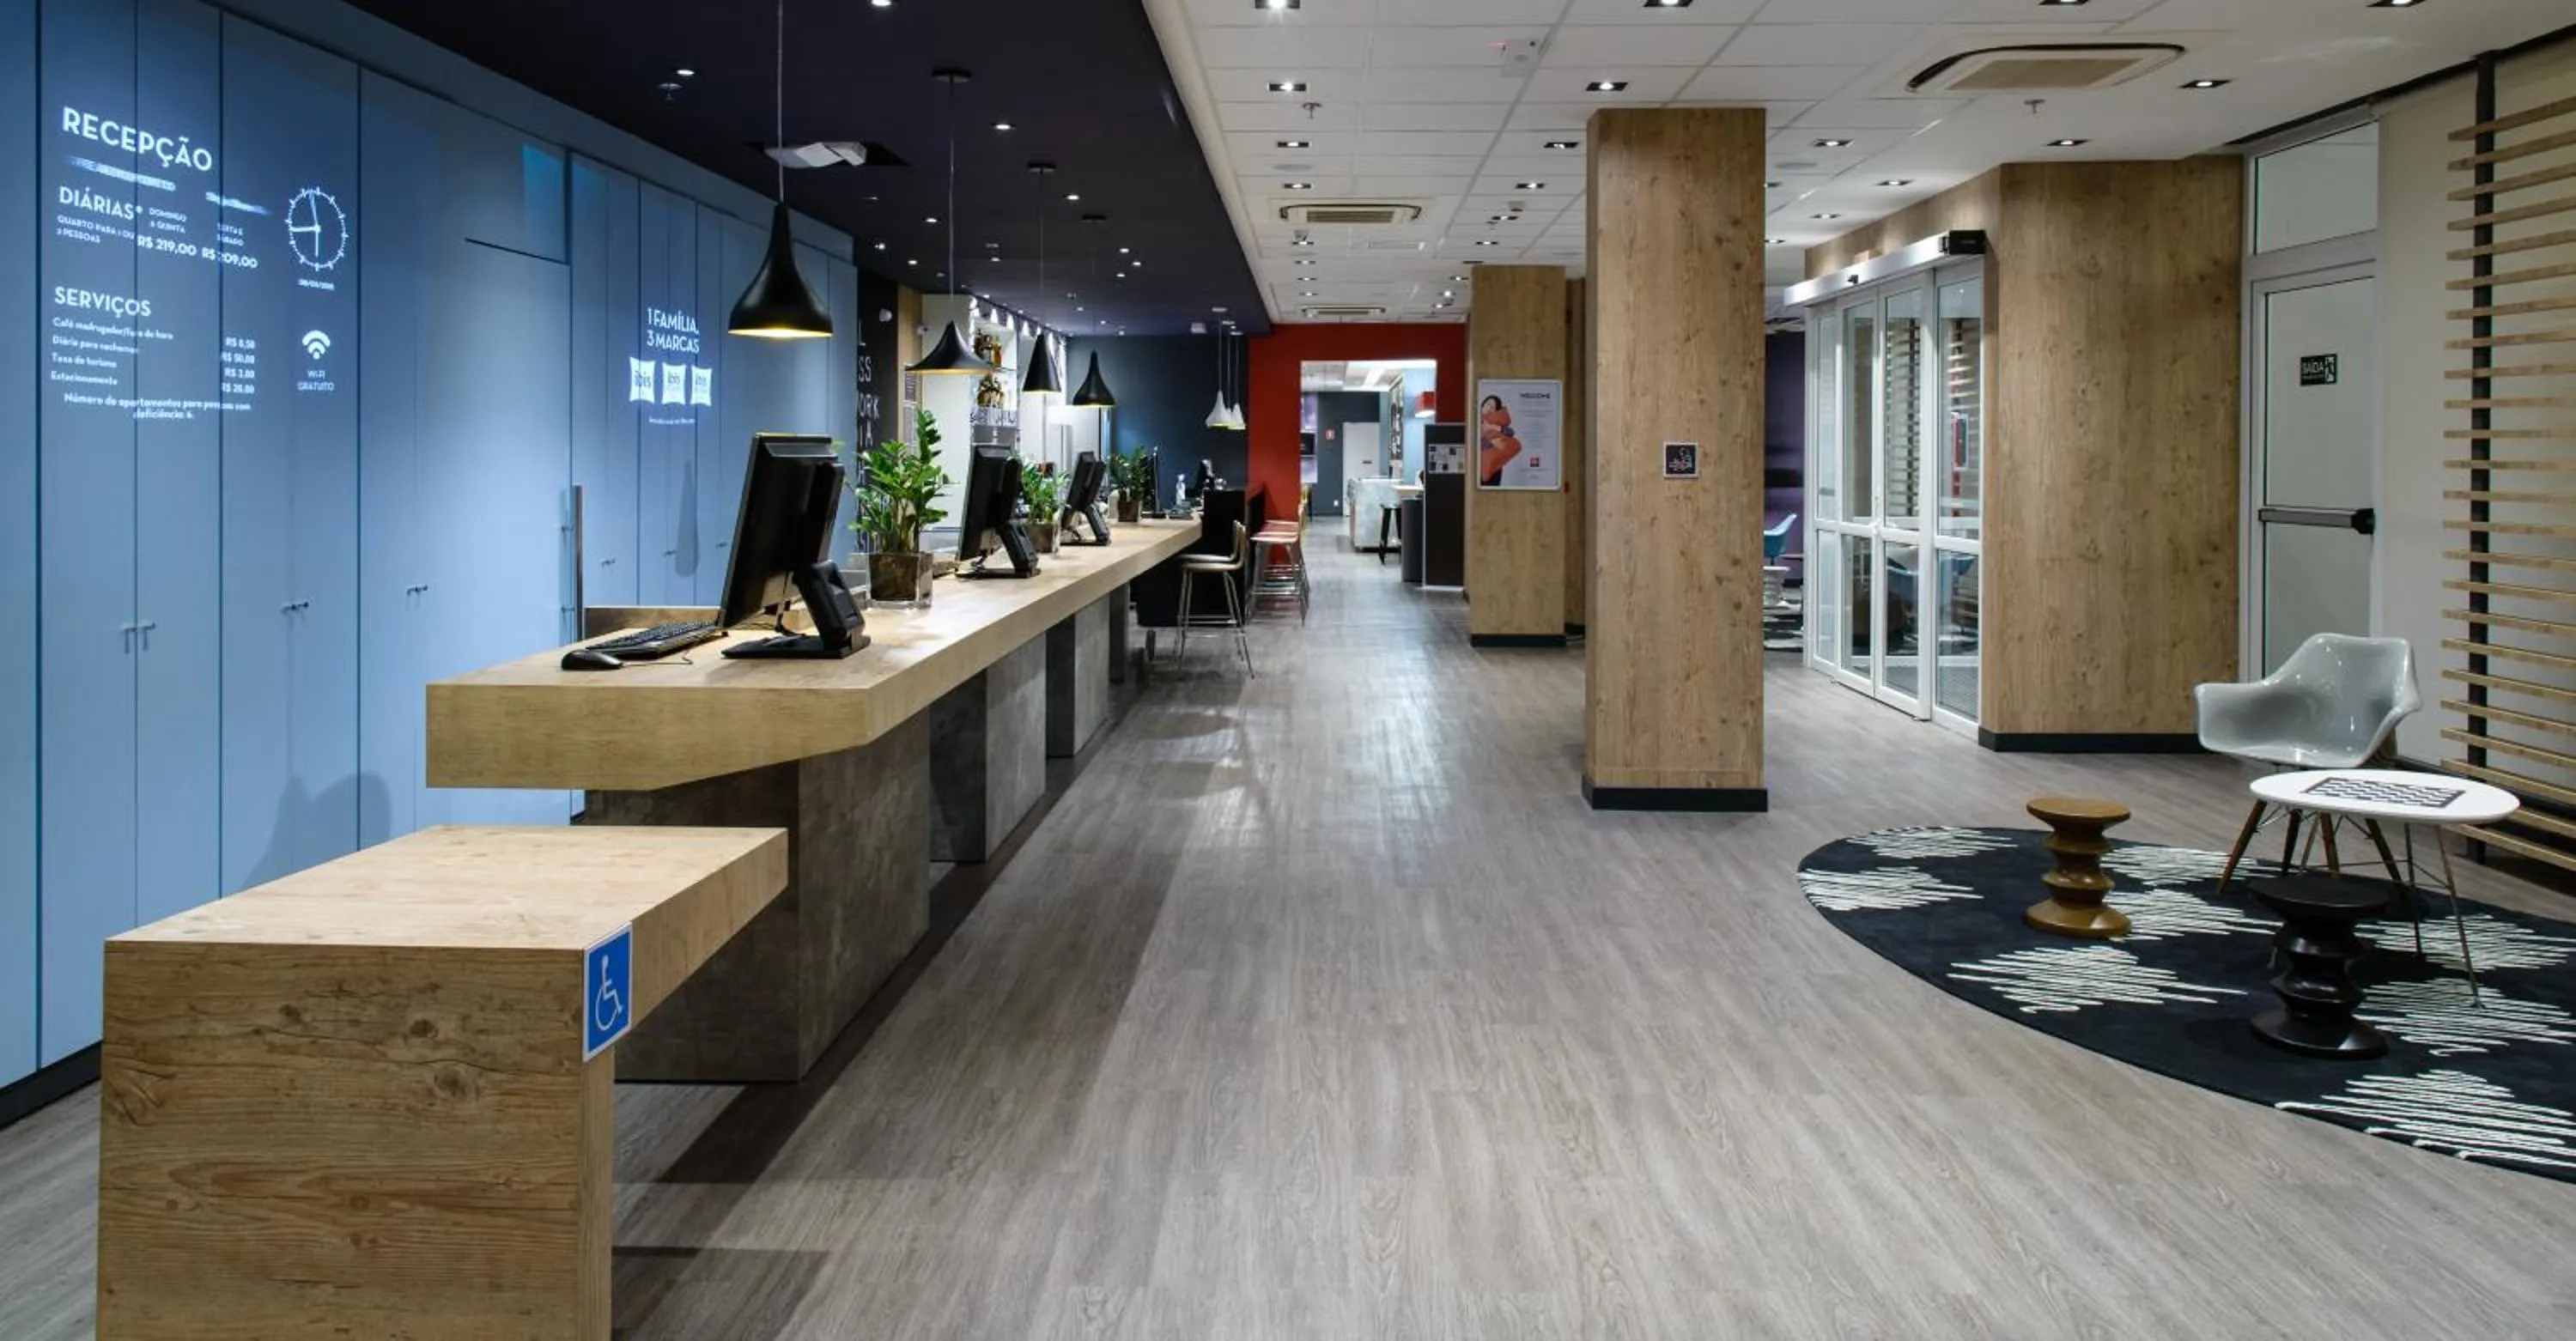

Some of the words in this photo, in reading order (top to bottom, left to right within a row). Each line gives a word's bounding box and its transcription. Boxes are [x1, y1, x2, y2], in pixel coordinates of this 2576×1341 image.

[63, 106, 212, 172] RECEPÇÃO
[57, 215, 94, 229] QUARTO
[137, 234, 154, 249] R$
[155, 238, 197, 257] 219,00
[202, 246, 216, 260] R$
[55, 286, 151, 318] SERVIÇOS
[52, 317, 74, 330] Café
[647, 306, 653, 325] 1
[653, 309, 699, 335] FAMÍLIA,
[647, 330, 654, 346] 3
[655, 331, 700, 354] MARCAS
[64, 392, 103, 406] Número
[104, 395, 117, 406] de
